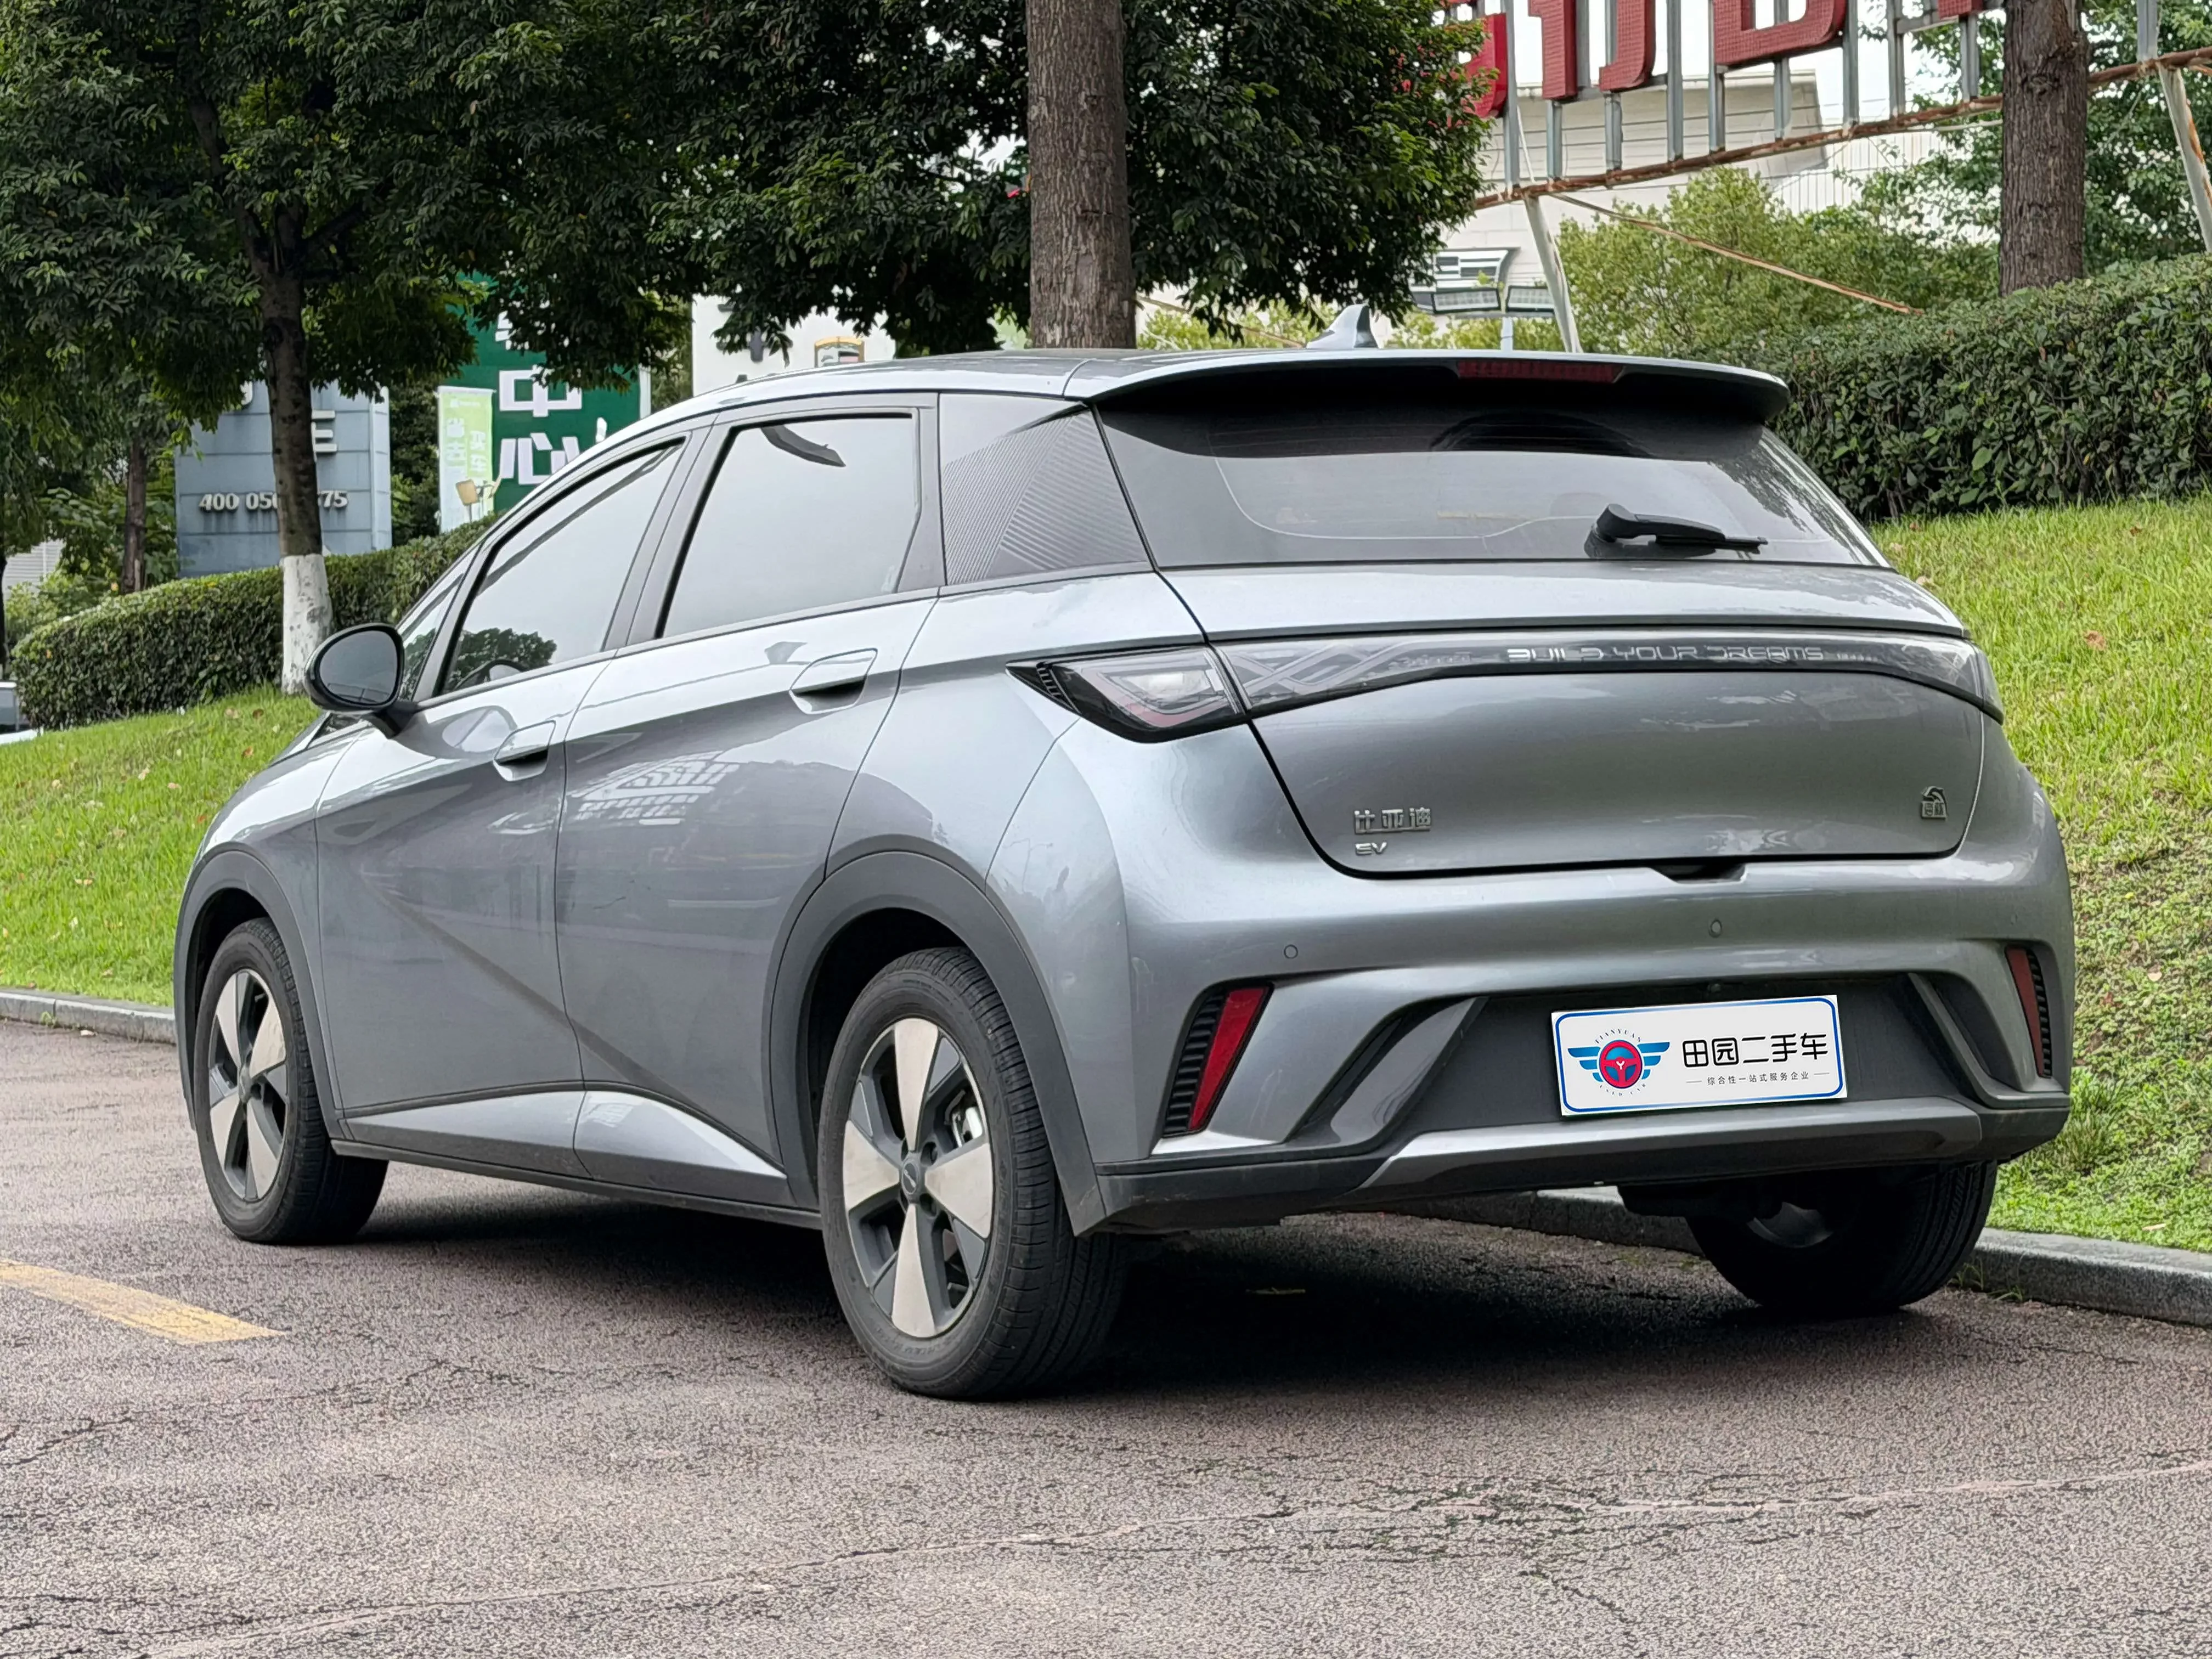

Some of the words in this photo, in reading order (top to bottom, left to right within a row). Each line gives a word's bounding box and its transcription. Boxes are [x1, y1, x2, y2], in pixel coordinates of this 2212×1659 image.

[496, 312, 580, 485] 中心
[198, 493, 240, 511] 400
[317, 490, 350, 508] 75
[1613, 646, 1698, 661] YOUR
[1705, 646, 1824, 662] DREAMS
[1354, 807, 1431, 834] 比亚迪
[1355, 842, 1387, 855] EV
